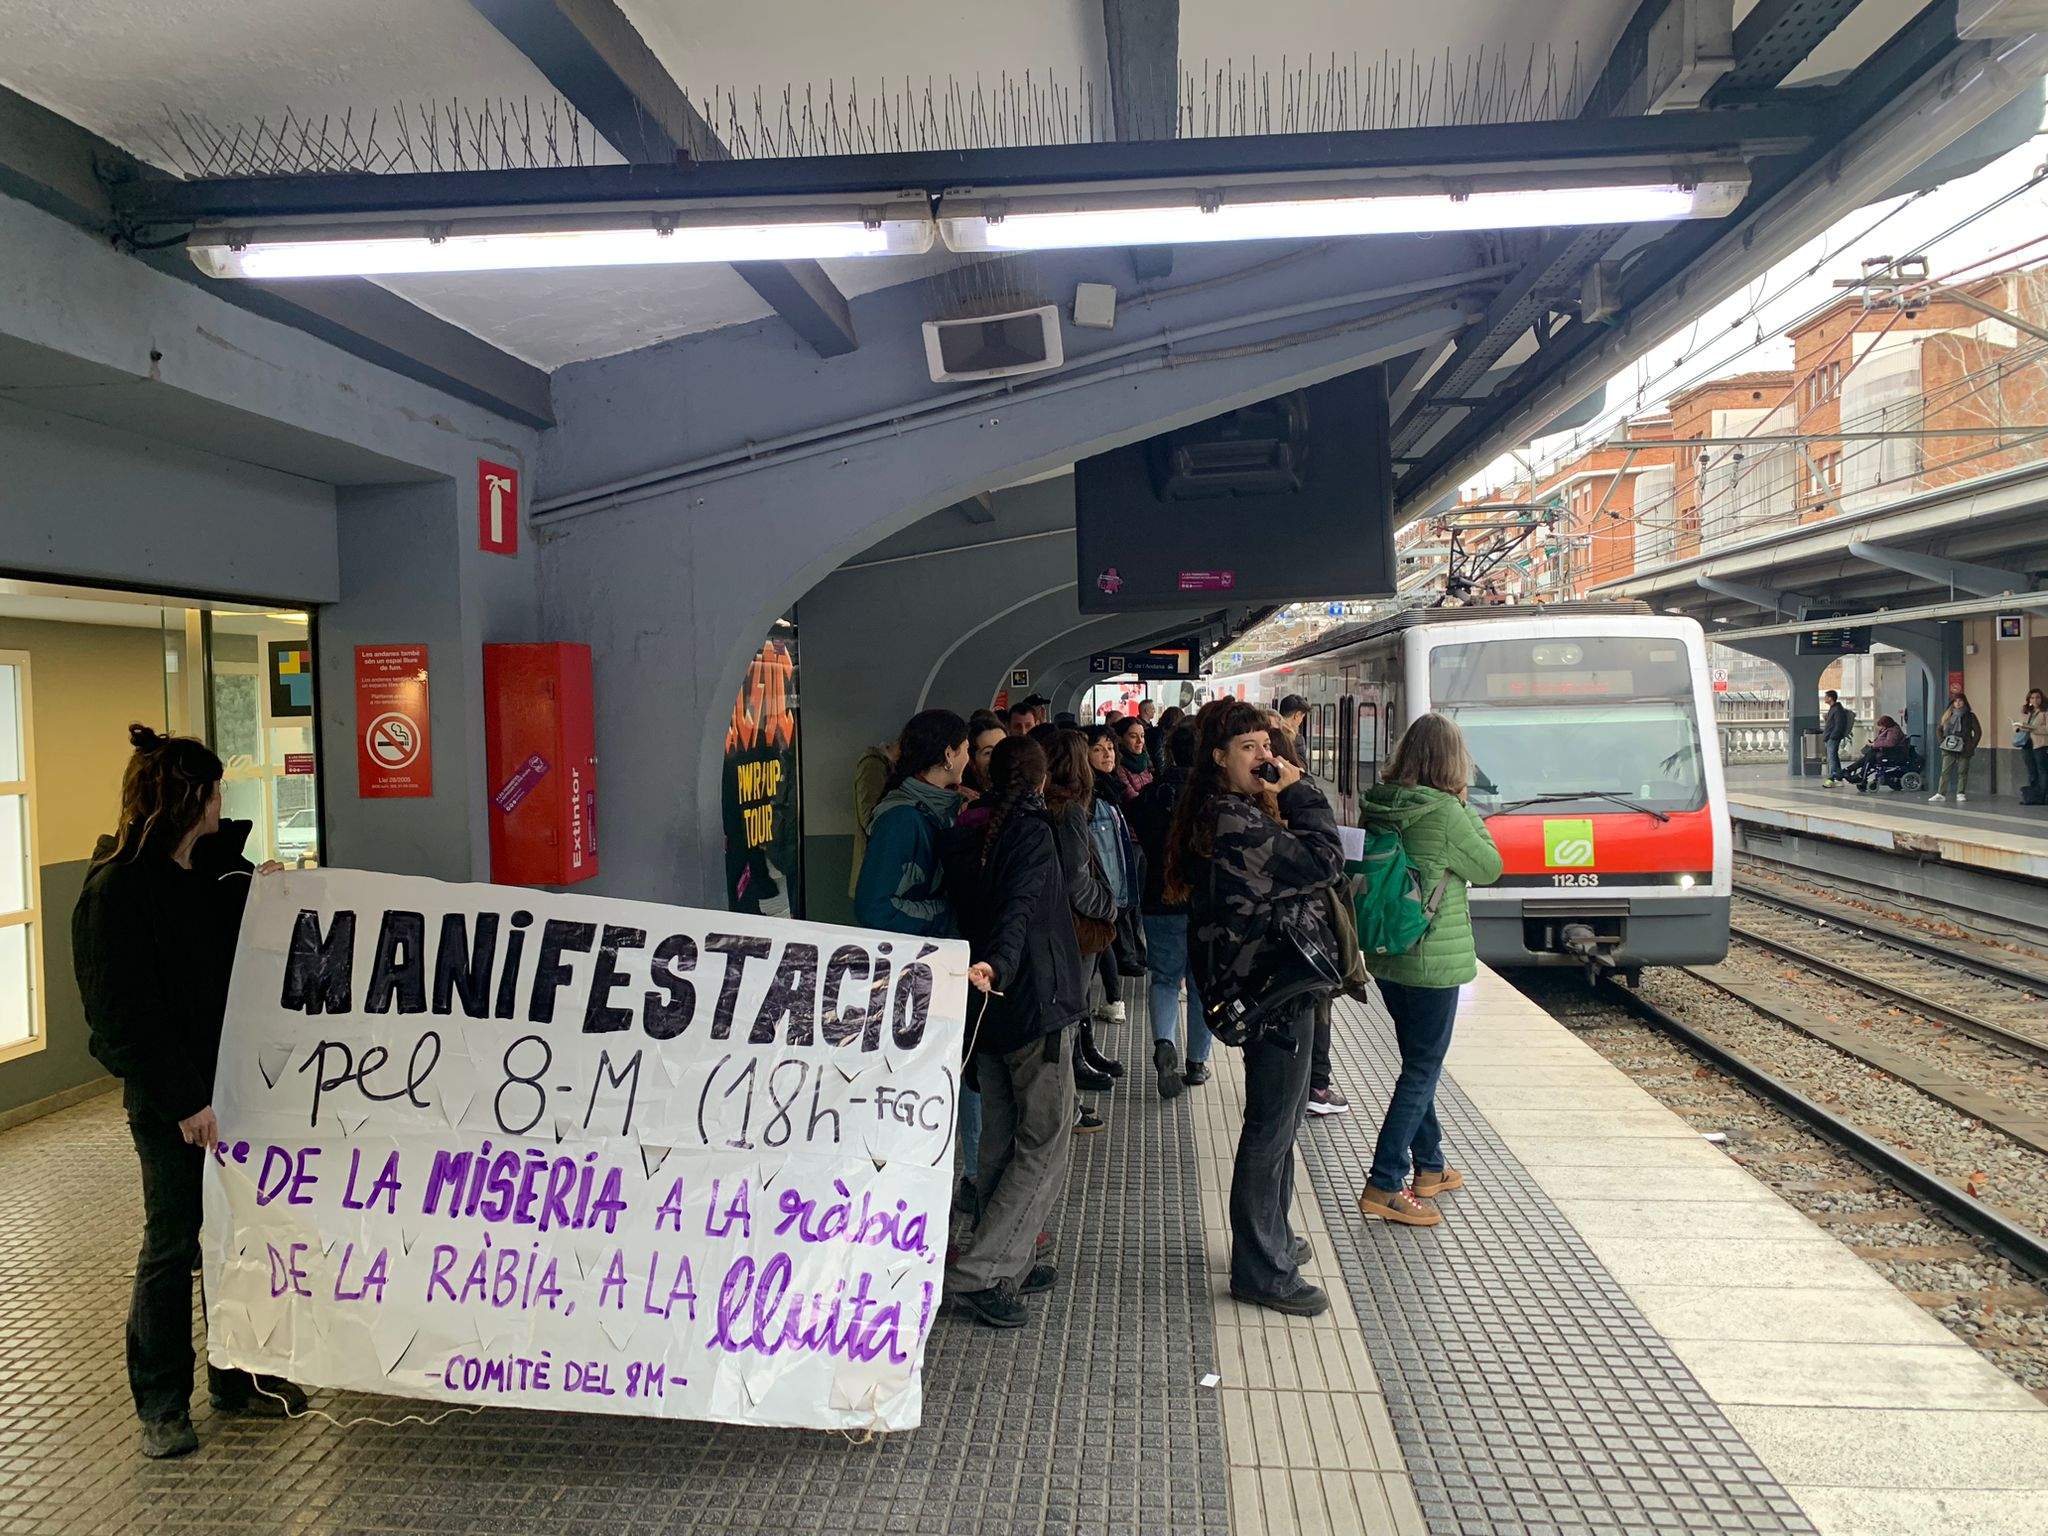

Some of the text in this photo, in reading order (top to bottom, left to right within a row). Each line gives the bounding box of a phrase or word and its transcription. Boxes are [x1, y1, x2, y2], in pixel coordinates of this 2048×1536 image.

[571, 767, 582, 868] Extintor
[744, 804, 773, 849] TOUR
[1552, 873, 1599, 888] 112.63
[298, 1031, 440, 1128] pel
[494, 1035, 643, 1137] 8-M
[342, 1147, 402, 1214] LA
[654, 1176, 683, 1232] A
[705, 1178, 751, 1238] LA
[266, 1242, 313, 1299] DE
[334, 1243, 389, 1303] LA
[598, 1248, 628, 1309] A
[644, 1250, 698, 1320] LA
[563, 1360, 616, 1396] DEL
